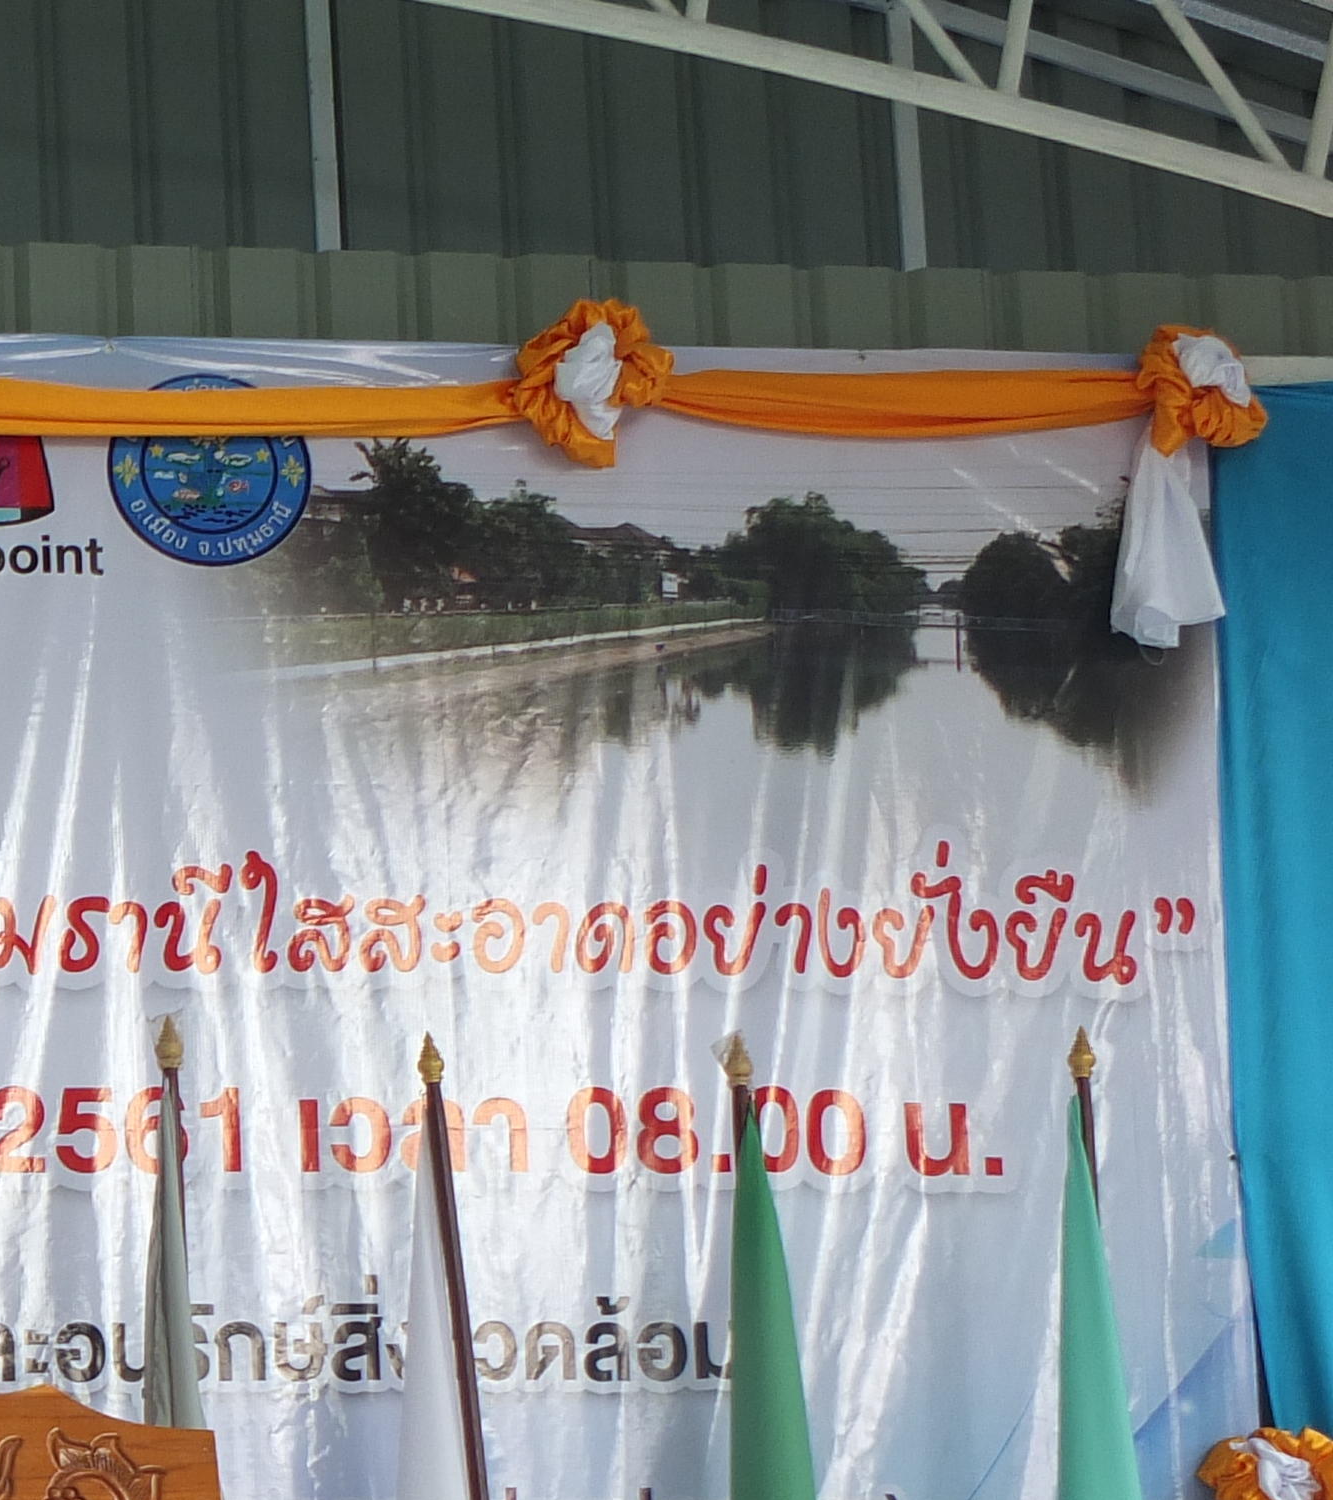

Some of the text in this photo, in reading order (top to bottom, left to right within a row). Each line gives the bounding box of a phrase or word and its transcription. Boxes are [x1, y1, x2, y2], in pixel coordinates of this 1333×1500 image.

[299, 1097, 528, 1174] เวลา
[566, 1085, 865, 1176] 08.00
[903, 1102, 1003, 1176] น.
